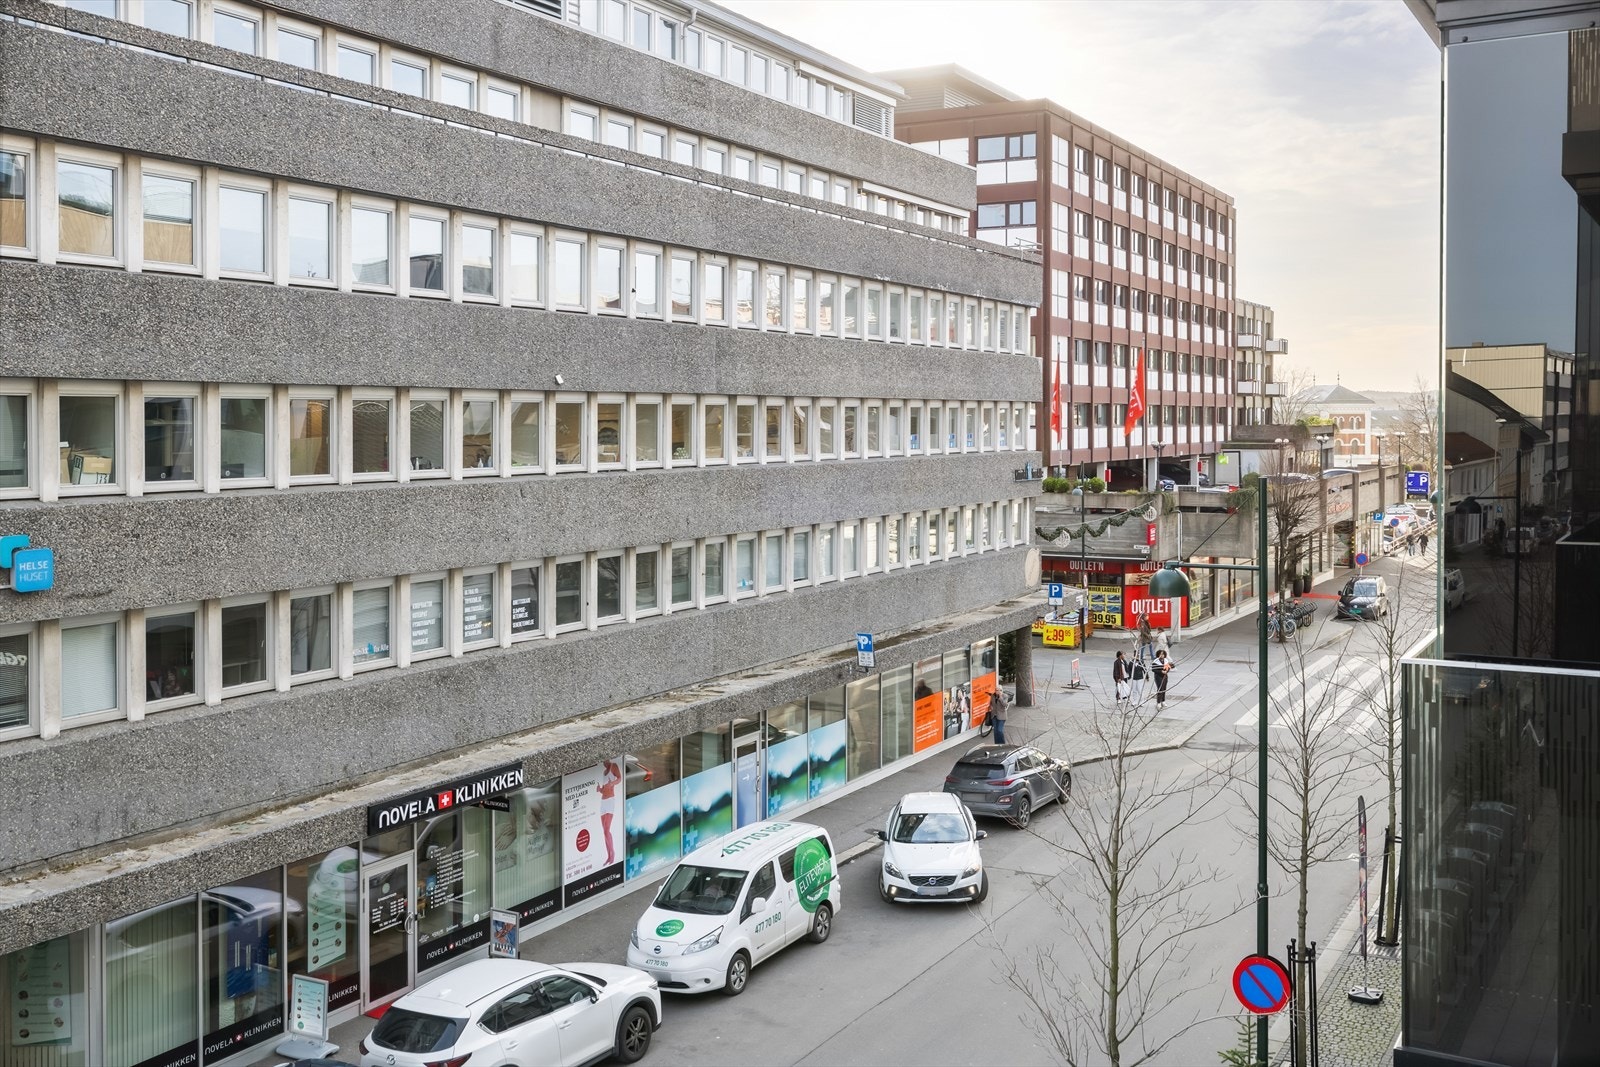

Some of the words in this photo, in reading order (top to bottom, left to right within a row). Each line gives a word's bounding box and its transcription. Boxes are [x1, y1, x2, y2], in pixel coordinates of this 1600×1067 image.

[1419, 476, 1428, 486] P
[19, 560, 48, 571] HELSE
[19, 571, 48, 582] HUSET
[1051, 585, 1060, 597] P
[1131, 598, 1170, 614] OUTLET
[455, 769, 524, 805] KLINIKKEN
[565, 792, 576, 802] MED
[576, 790, 589, 799] LASER
[723, 840, 752, 855] 477
[528, 899, 554, 915] KLINIKKEN
[754, 921, 765, 933] 477
[764, 917, 772, 928] 70
[772, 911, 782, 924] 180
[455, 930, 483, 948] KLINIKKEN
[328, 984, 358, 1002] LINIKKEN
[244, 1016, 282, 1038] KLINIKKEN
